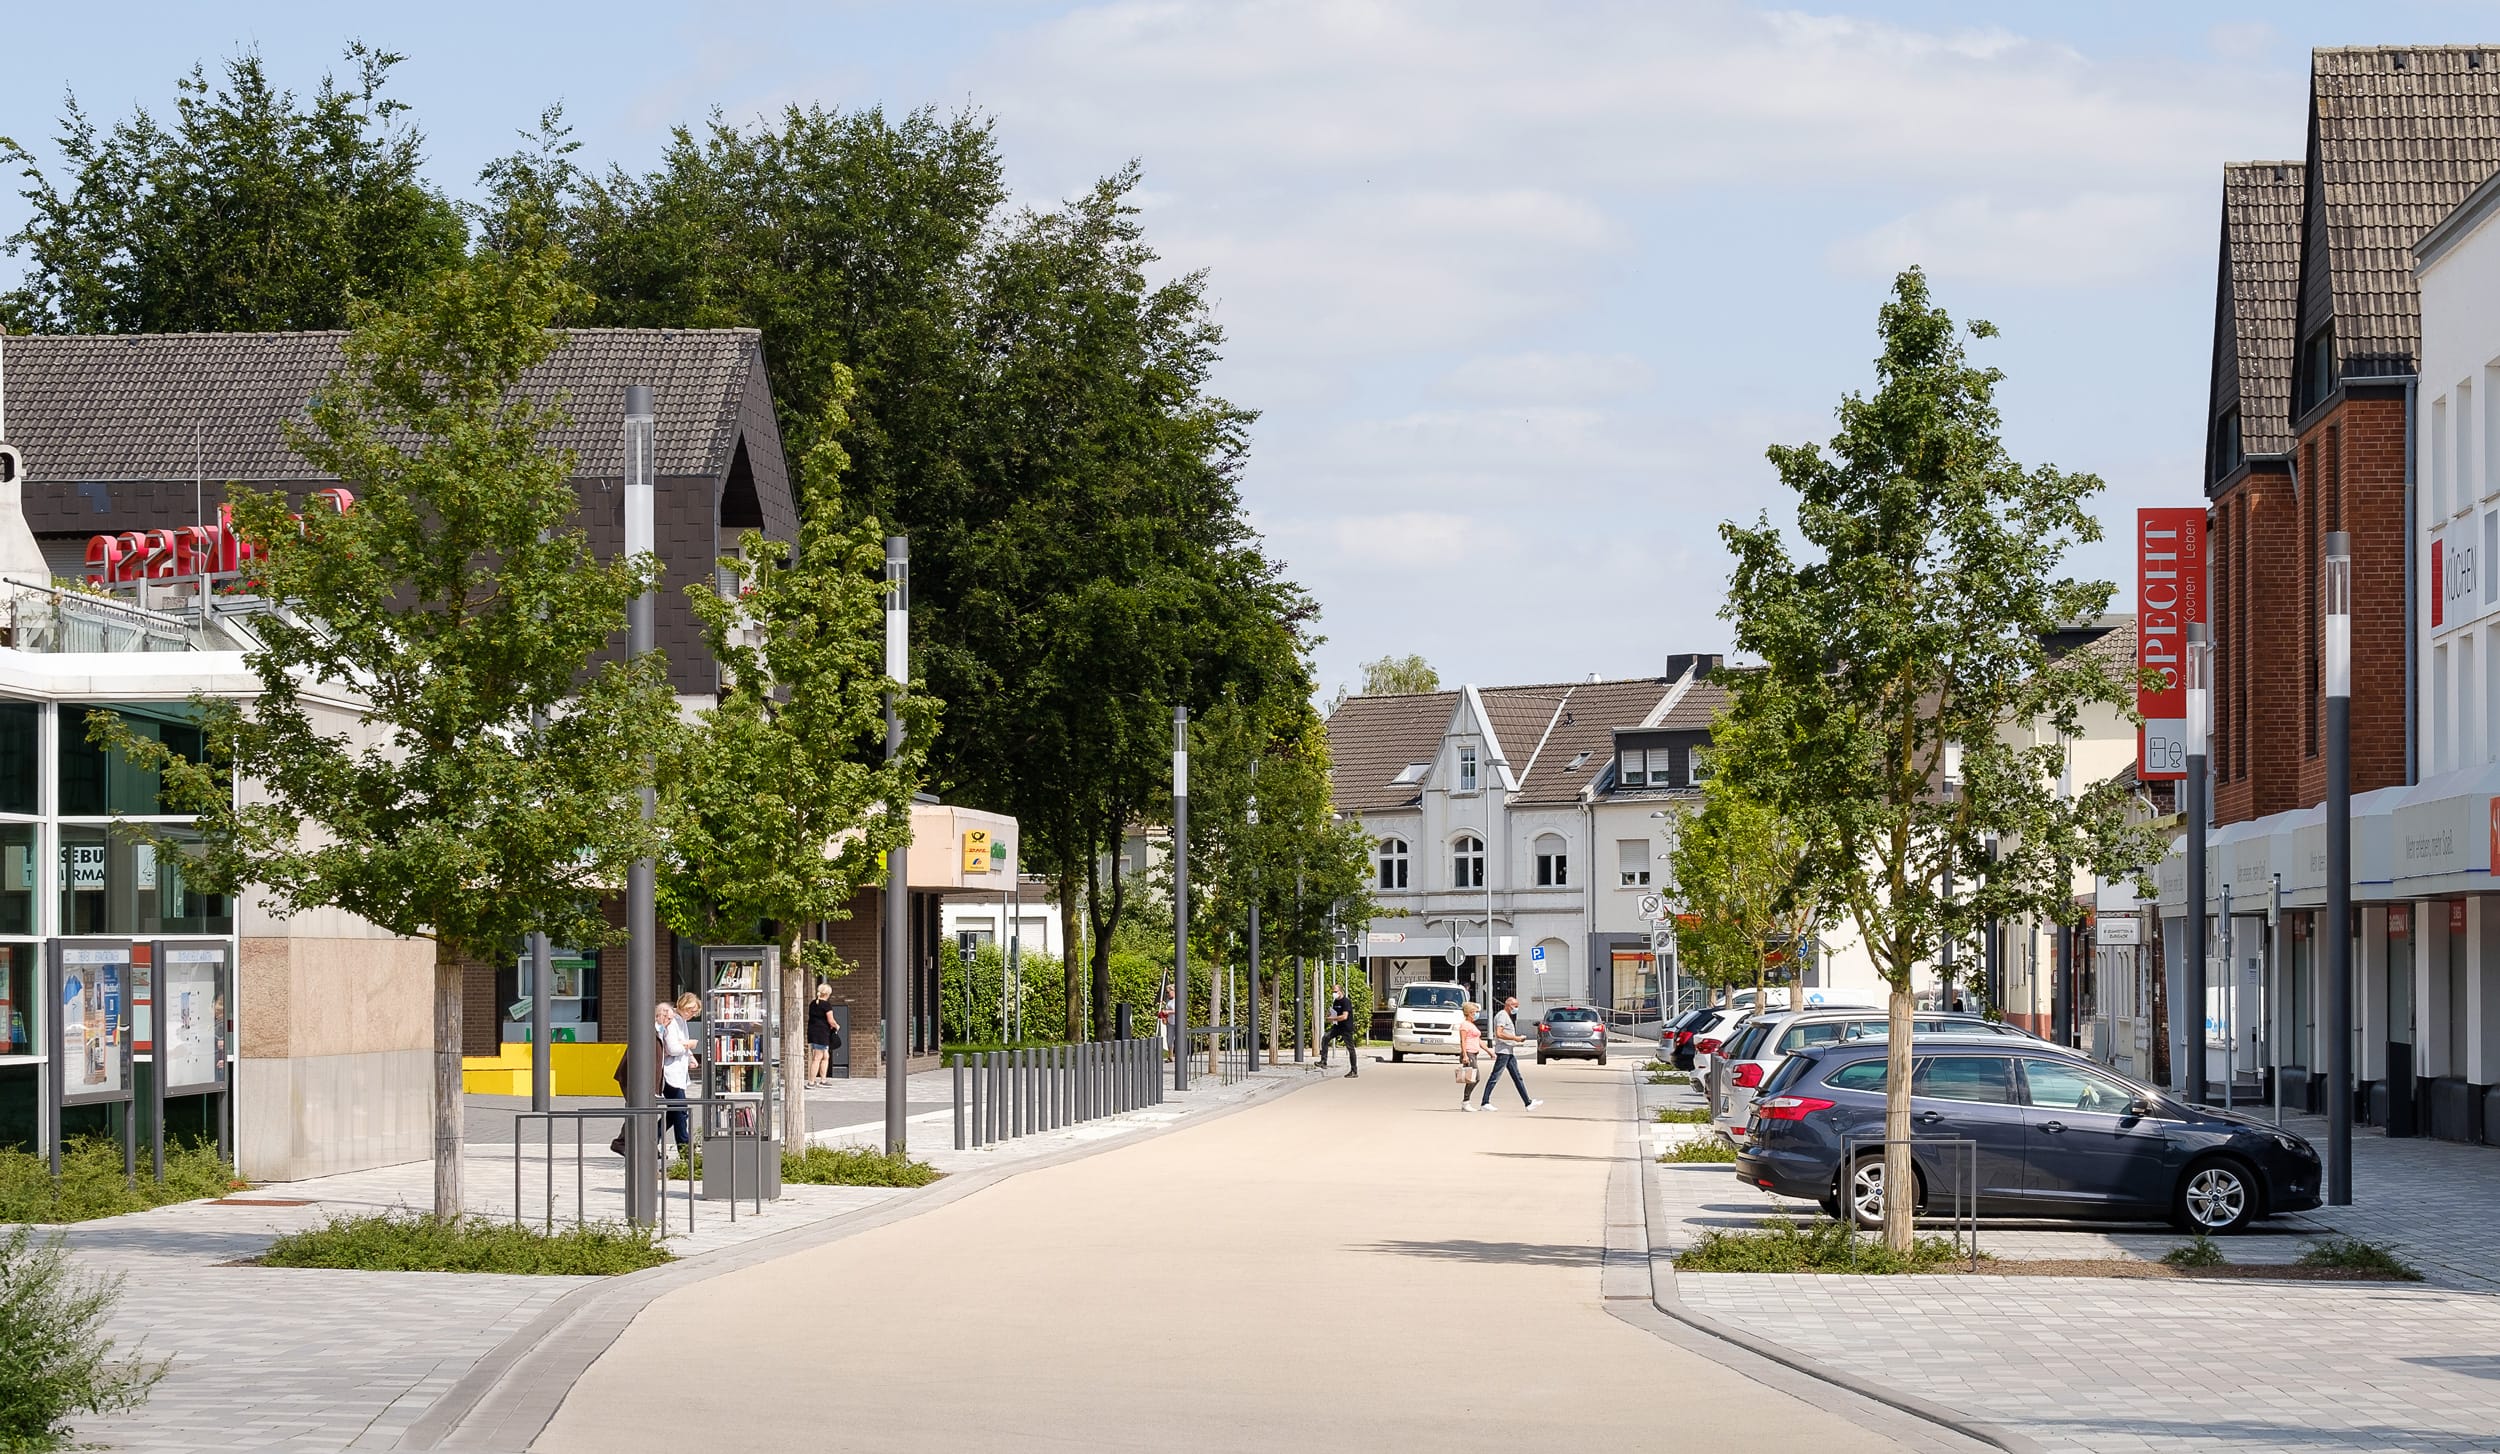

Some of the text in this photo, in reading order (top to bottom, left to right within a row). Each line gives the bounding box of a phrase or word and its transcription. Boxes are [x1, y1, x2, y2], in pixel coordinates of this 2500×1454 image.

[2184, 519, 2196, 559] Leben
[2445, 544, 2477, 603] KÜCHEN
[2184, 575, 2196, 624] Kochen
[1533, 949, 1541, 959] P
[721, 977, 753, 986] BÜCH
